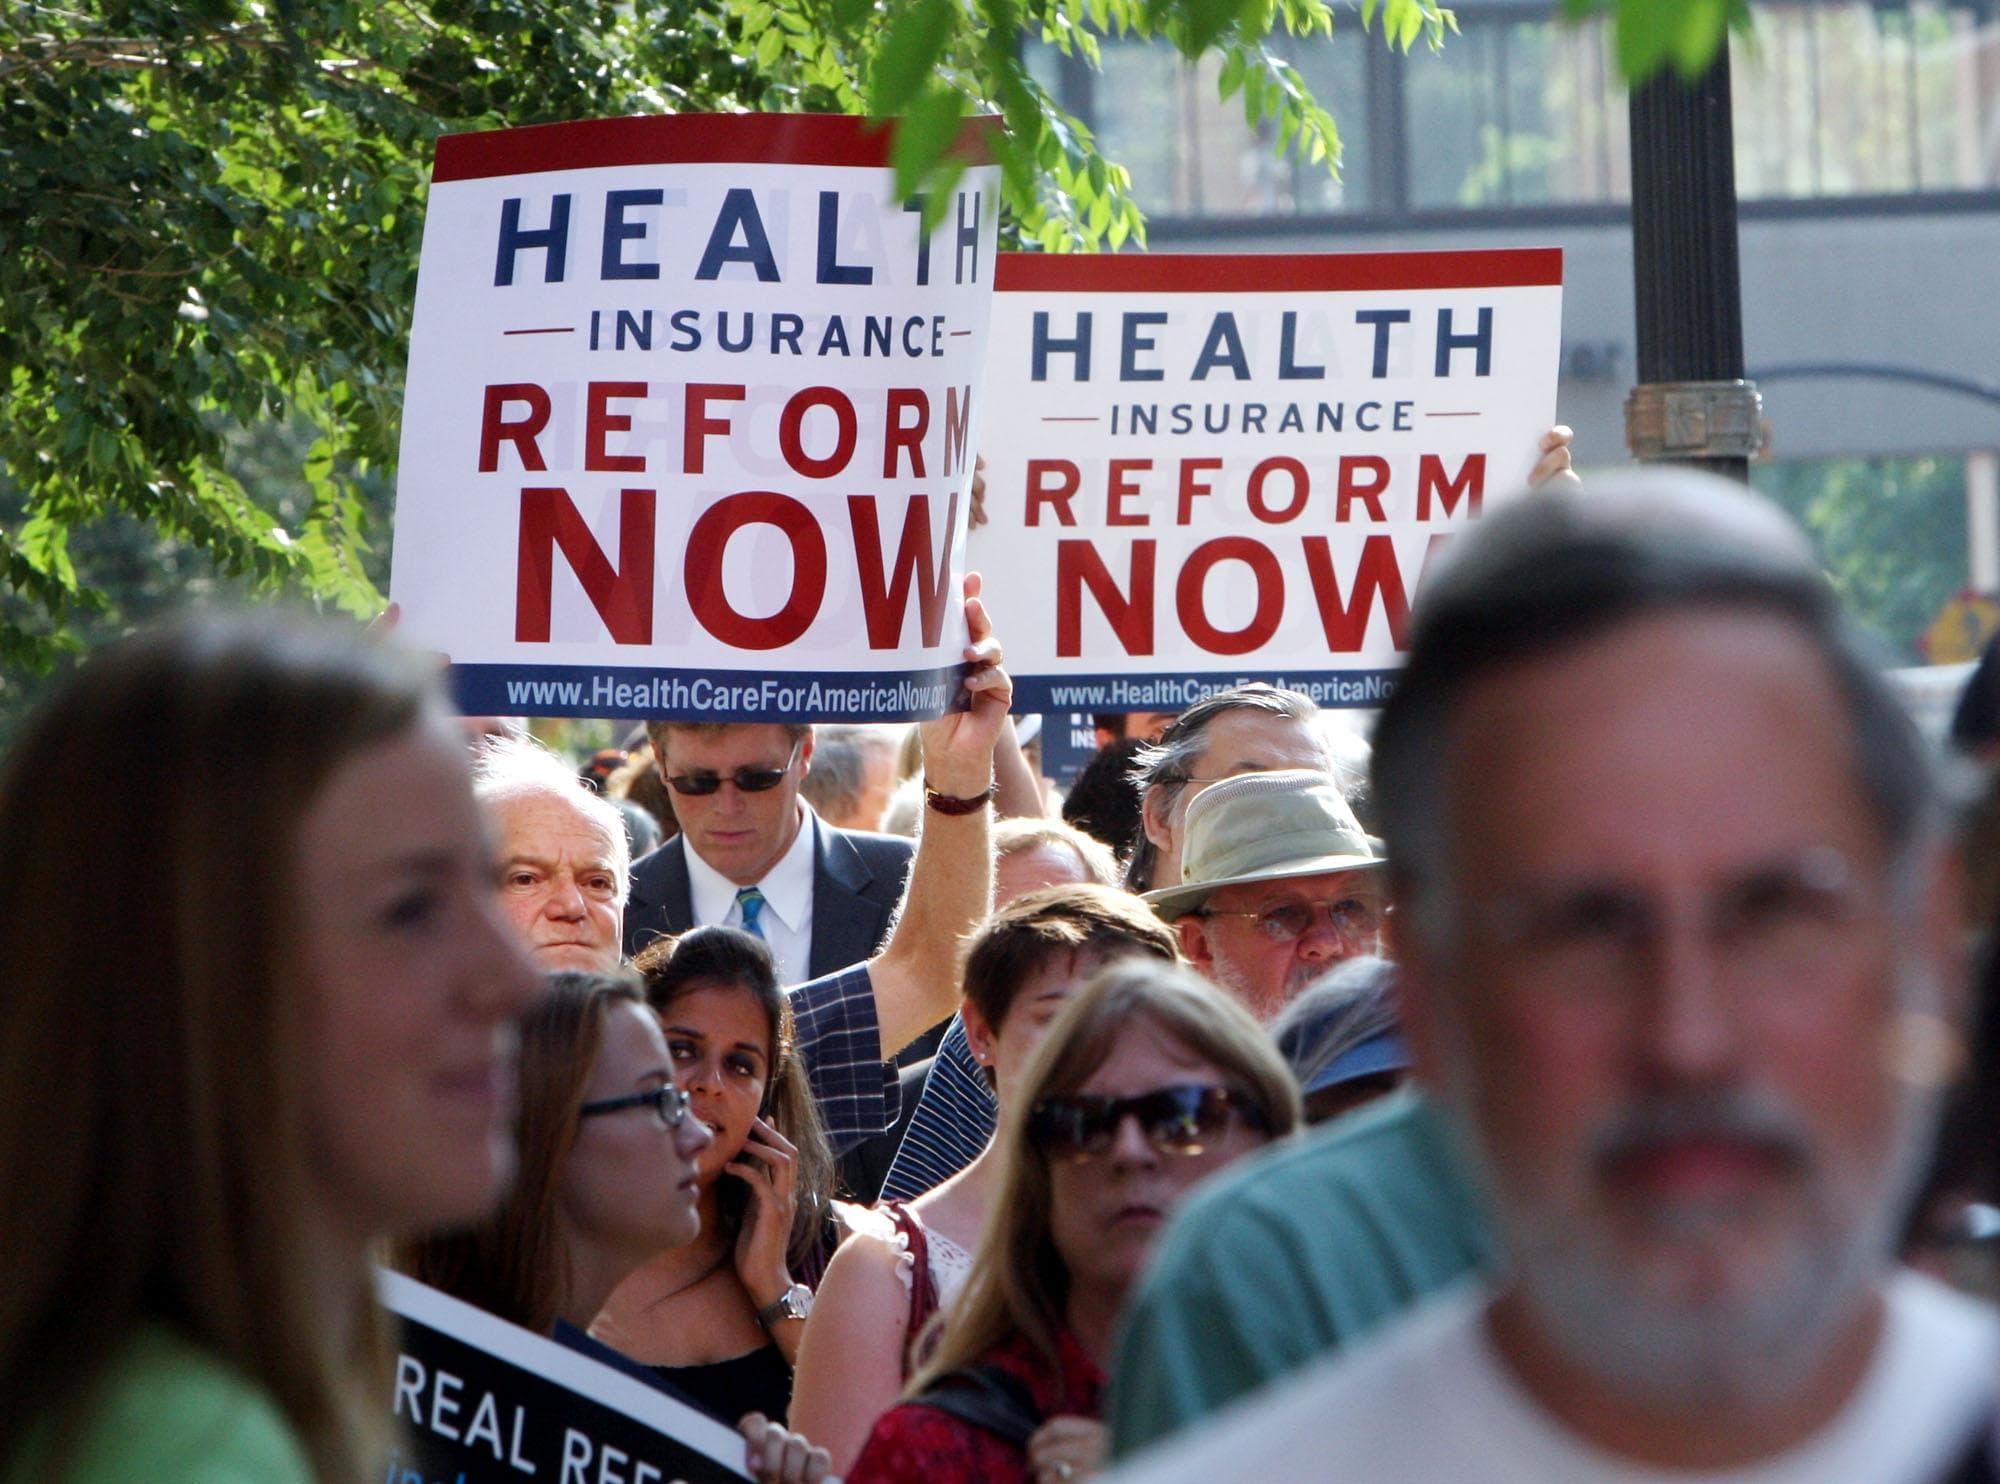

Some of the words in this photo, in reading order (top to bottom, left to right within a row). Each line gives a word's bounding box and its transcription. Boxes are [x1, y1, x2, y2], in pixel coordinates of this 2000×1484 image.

[494, 188, 980, 286] HEALTH
[589, 310, 946, 357] INSURANCE
[1031, 306, 1494, 381] HEALTH
[478, 381, 971, 479] REFORM
[1110, 401, 1415, 435] INSURANCE
[1024, 453, 1487, 527] REFORM
[514, 487, 959, 650] NOW
[1056, 533, 1452, 657] NOW
[507, 676, 947, 715] www.HealthCareForAmericaNow.org
[393, 1354, 536, 1475] REAL
